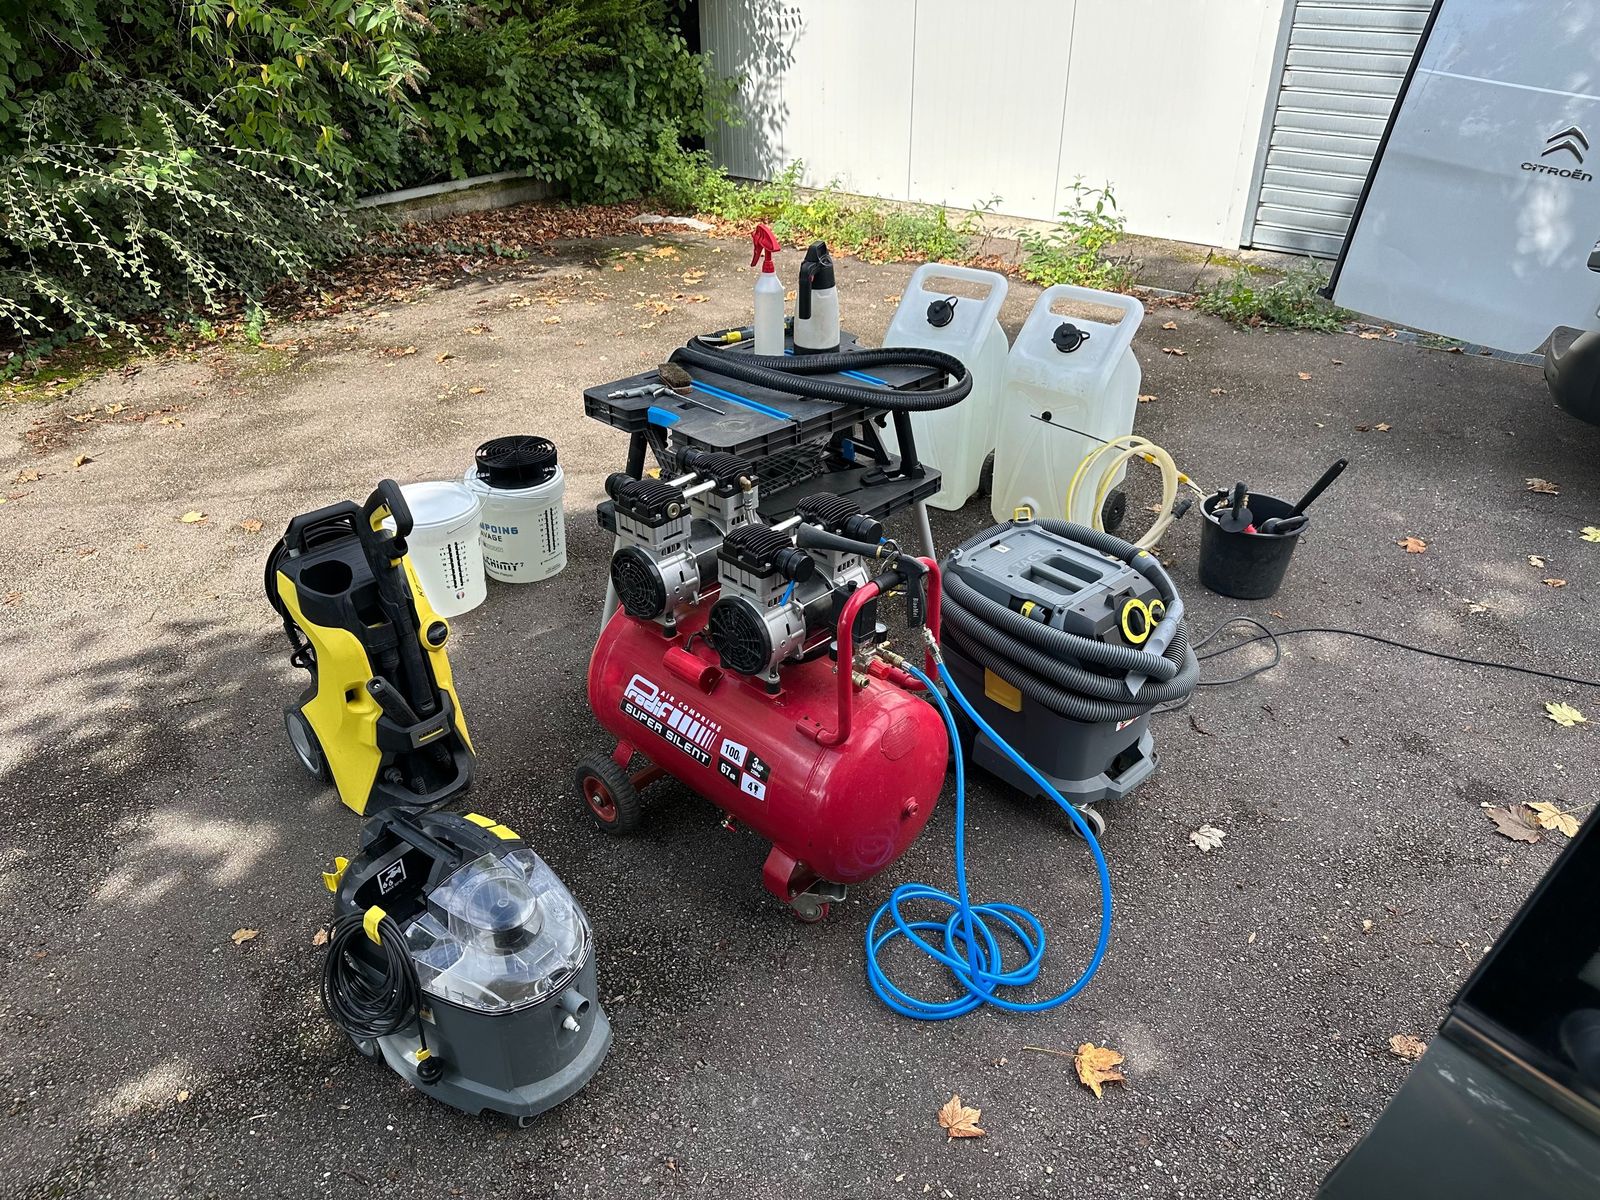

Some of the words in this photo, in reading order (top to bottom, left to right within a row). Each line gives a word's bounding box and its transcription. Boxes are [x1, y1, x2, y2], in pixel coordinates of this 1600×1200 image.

[660, 690, 676, 703] AIR
[624, 702, 663, 734] SUPER
[665, 730, 709, 763] SILENT
